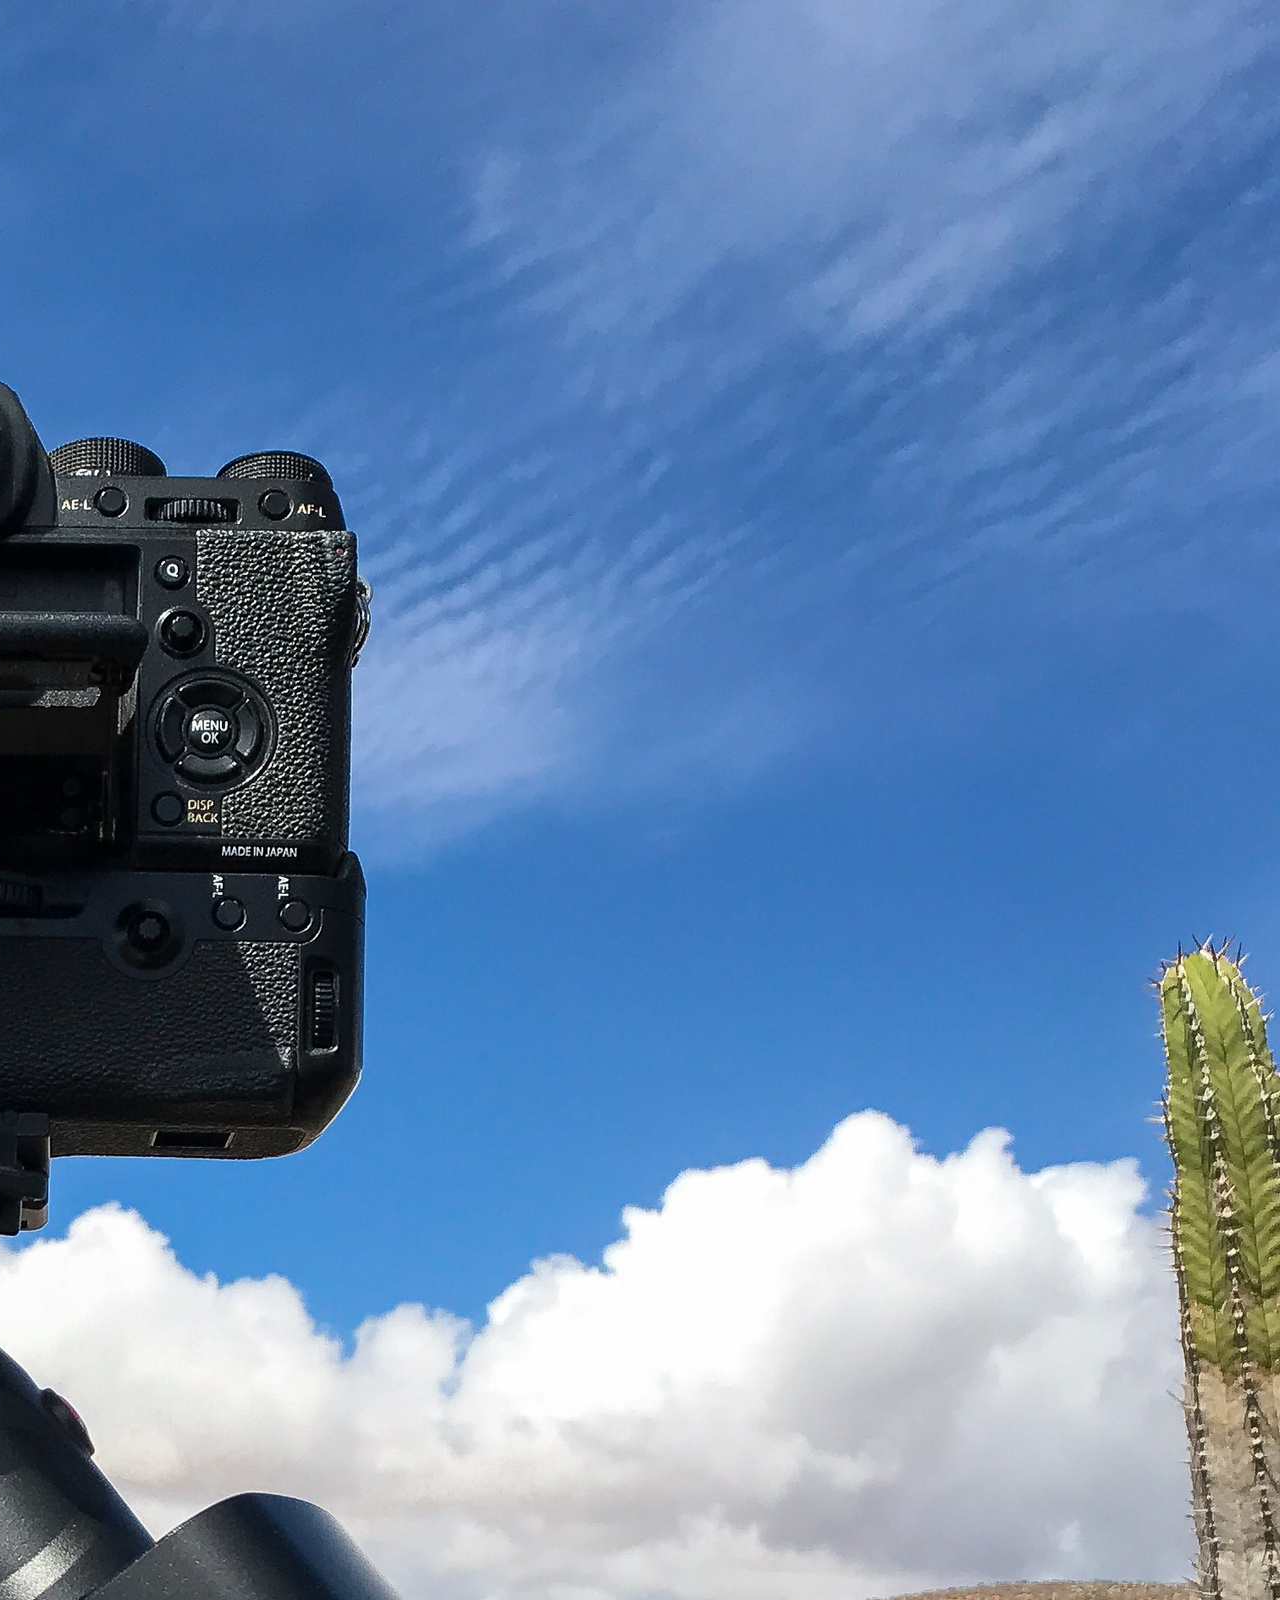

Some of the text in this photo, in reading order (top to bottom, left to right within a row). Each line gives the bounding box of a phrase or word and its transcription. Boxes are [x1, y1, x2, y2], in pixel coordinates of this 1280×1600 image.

[166, 564, 179, 578] Q
[191, 720, 228, 732] MENU
[201, 732, 219, 744] OK
[187, 800, 214, 811] DISP
[187, 812, 219, 824] BACK
[221, 845, 298, 859] MADE IN JAPAN
